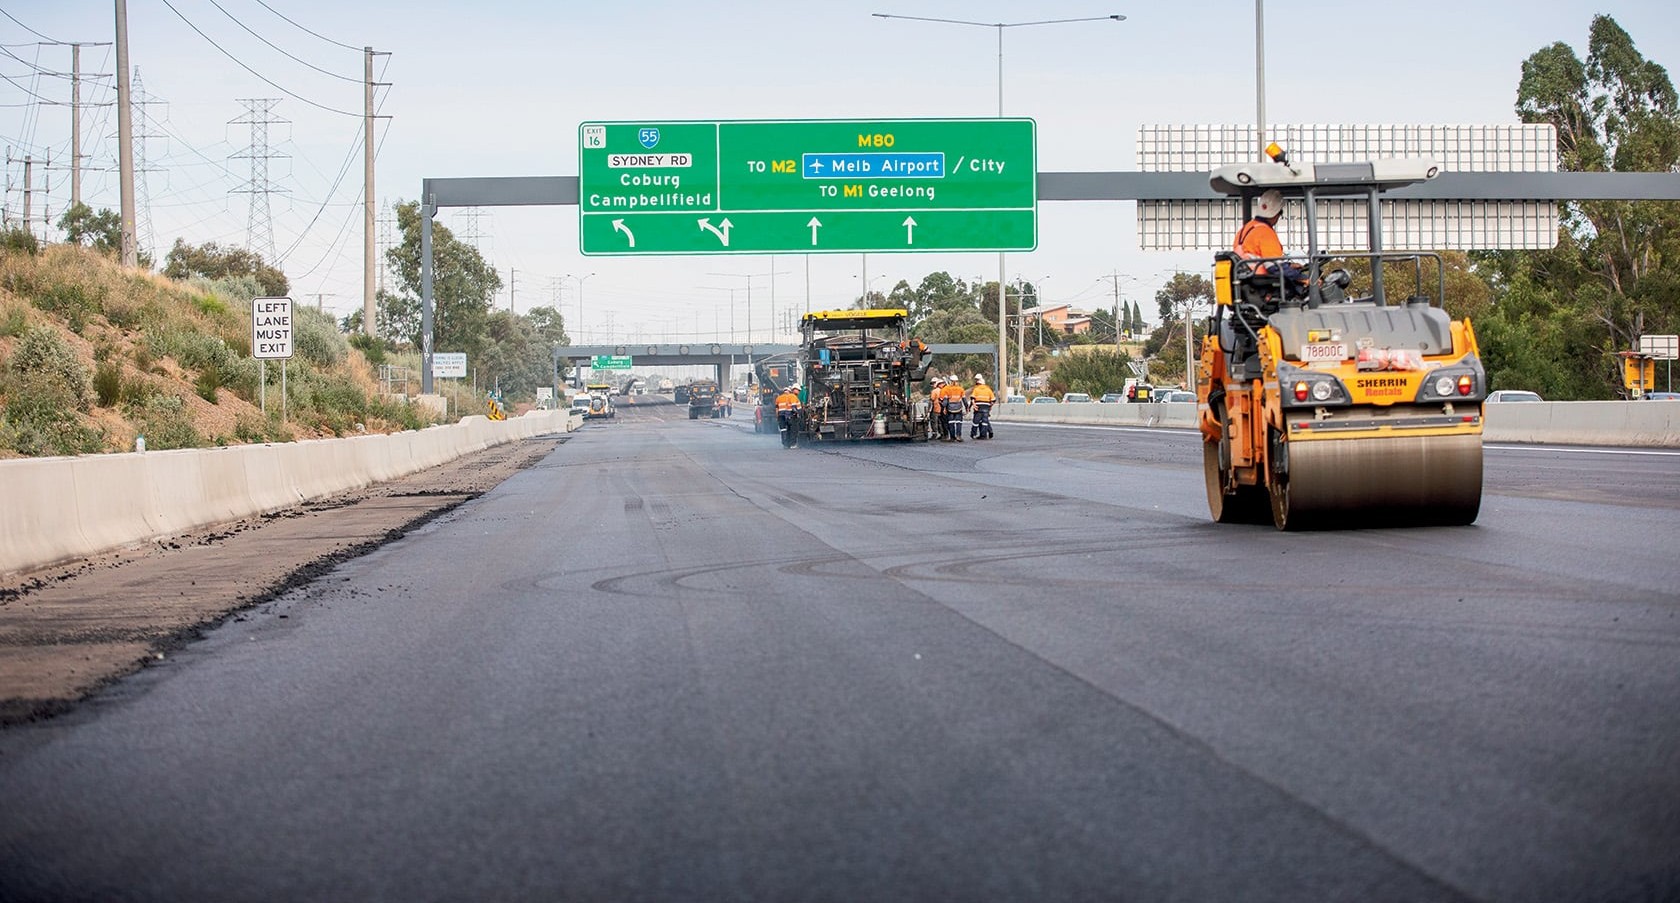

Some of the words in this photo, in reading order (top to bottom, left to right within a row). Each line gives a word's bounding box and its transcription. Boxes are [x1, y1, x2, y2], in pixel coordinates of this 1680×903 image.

[589, 137, 600, 146] 16
[642, 131, 657, 142] 55
[858, 134, 894, 147] M80
[613, 156, 663, 166] SYDNEY
[671, 156, 687, 164] RD
[747, 161, 766, 172] TO
[772, 160, 796, 172] M2
[832, 160, 870, 172] Melb
[882, 160, 938, 174] Airport
[970, 159, 1005, 174] City
[620, 174, 680, 188] Coburg
[819, 186, 837, 196] TO
[844, 185, 862, 197] M1
[868, 184, 935, 200] Geelong
[590, 193, 711, 208] Campbellfield
[258, 303, 287, 312] LEFT
[256, 316, 289, 326] LANE
[256, 330, 289, 340] MUST
[260, 344, 286, 352] EXIT
[1306, 346, 1343, 357] 78800C
[1357, 379, 1407, 388] SHERRIN
[1366, 388, 1402, 396] Rentals
